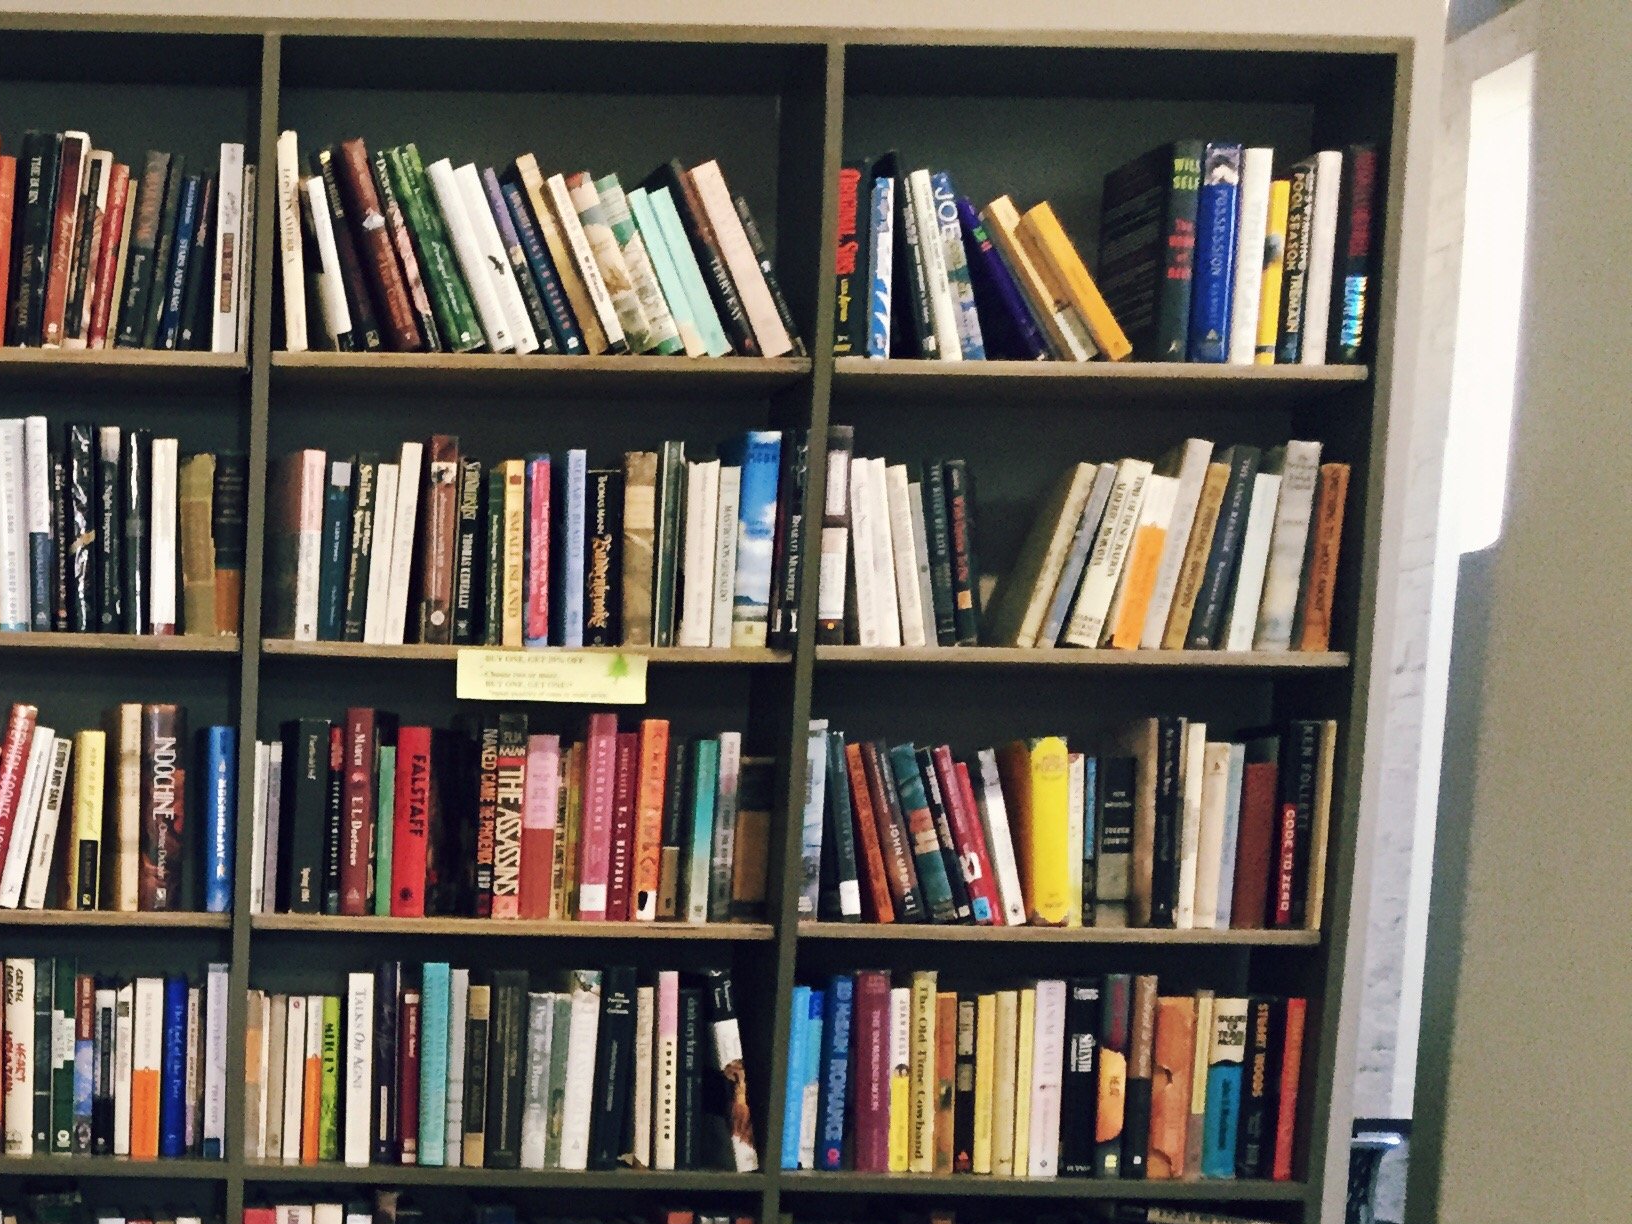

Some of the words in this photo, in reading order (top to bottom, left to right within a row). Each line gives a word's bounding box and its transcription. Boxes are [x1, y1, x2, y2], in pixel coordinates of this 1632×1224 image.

[30, 157, 42, 177] THE
[1173, 158, 1201, 172] WILL
[28, 178, 40, 203] BURN
[1172, 175, 1200, 190] SELF
[1291, 173, 1306, 209] POOL
[284, 198, 294, 210] IN
[934, 187, 961, 240] JOE
[284, 216, 295, 264] AMERICA
[1210, 189, 1227, 276] POSSESSION
[1286, 214, 1301, 271] SEASON
[174, 238, 187, 267] STARS
[173, 268, 183, 286] AND
[710, 256, 731, 295] TERRY
[725, 295, 741, 320] KAY
[170, 287, 182, 312] BARS
[1285, 275, 1304, 333] TREMAIN
[1239, 459, 1252, 478] THE
[102, 485, 113, 510] Night
[597, 476, 608, 508] THOMAS
[1233, 483, 1245, 508] LACE
[101, 512, 112, 553] Inspector
[508, 510, 521, 557] SMALL
[597, 509, 607, 535] MANN
[1222, 512, 1239, 552] READER
[461, 534, 474, 566] THOMAS
[458, 568, 472, 609] KENEALLY
[507, 564, 520, 618] ISLAND
[587, 534, 613, 628] Buddenbrooks
[785, 555, 798, 601] MUKHERJEE
[4, 717, 30, 770] STEPHEN
[54, 741, 68, 768] BLOOD
[354, 733, 365, 766] MARCH
[481, 728, 498, 770] NAKED
[1302, 725, 1314, 756] KEN
[50, 769, 63, 787] AND
[152, 736, 177, 821] INDOCHINE
[480, 773, 496, 802] CAME
[497, 765, 525, 805] THE
[593, 739, 606, 831] WATERBORNE
[46, 788, 60, 811] SAND
[408, 754, 427, 838] FALSTAFF
[556, 786, 568, 829] CEREMONY
[1297, 763, 1313, 830] FOLLETT
[83, 800, 97, 833] good
[216, 779, 227, 858] MOCKINGJAY
[1283, 810, 1296, 847] CODE
[349, 820, 362, 867] Doctorow
[477, 820, 493, 865] PHOENIX
[492, 807, 523, 896] ASSASSINS
[556, 833, 566, 842] IN
[888, 823, 905, 856] JOHN
[613, 840, 626, 889] NAIPAUL
[1282, 851, 1293, 869] TO
[554, 868, 564, 890] TREE
[1280, 874, 1292, 911] ZERO
[15, 968, 24, 1002] GRETEL
[838, 981, 853, 1000] ED
[919, 986, 929, 1013] The
[174, 1005, 182, 1021] The
[354, 989, 367, 1028] TALKS
[686, 997, 698, 1021] don't
[898, 999, 906, 1026] JOAN
[173, 1025, 182, 1043] End
[685, 1023, 696, 1038] cry
[898, 1030, 906, 1056] HESS
[1255, 1003, 1269, 1049] STUART
[15, 1043, 26, 1083] HEART
[173, 1060, 181, 1075] the
[352, 1056, 364, 1089] AGNI
[685, 1055, 694, 1070] me
[1251, 1053, 1267, 1097] WOODS
[663, 1084, 672, 1140] O'BRIEN
[825, 1059, 848, 1141] ROMANCE
[914, 1090, 926, 1159] Cowhand
